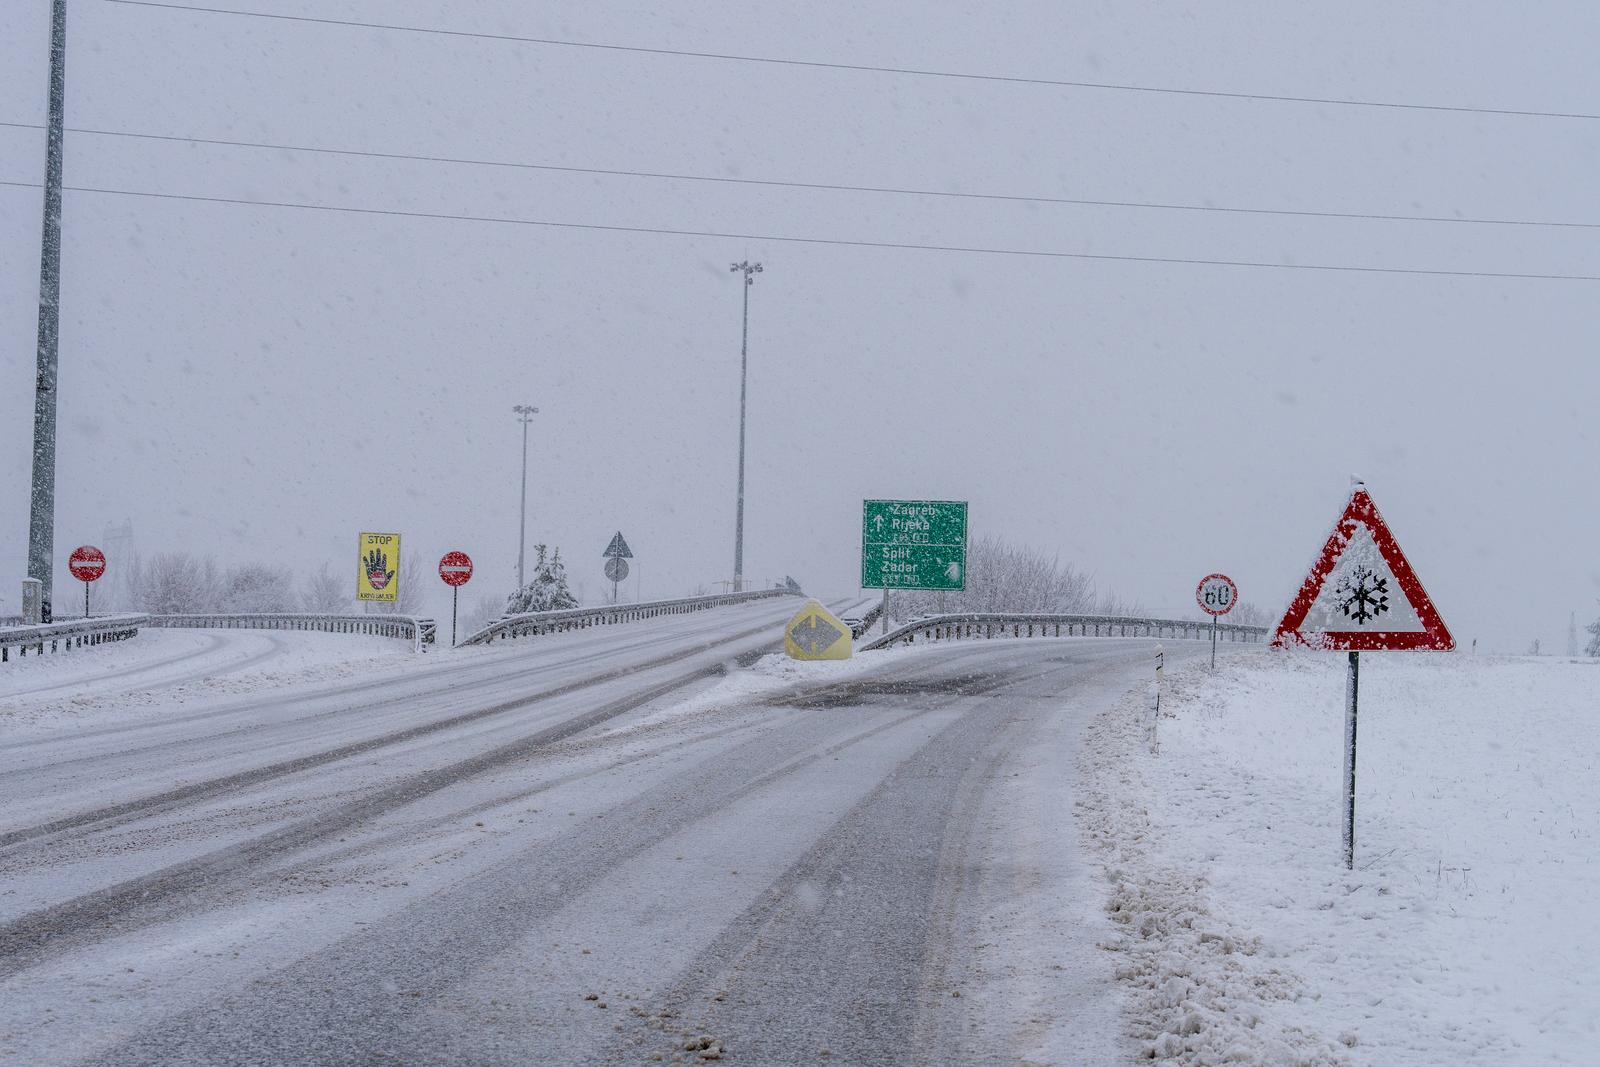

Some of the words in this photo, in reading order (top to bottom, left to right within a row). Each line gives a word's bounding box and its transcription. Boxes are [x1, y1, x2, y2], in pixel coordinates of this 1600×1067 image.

[893, 504, 936, 517] Zagreb
[892, 518, 930, 532] Rijeka
[368, 535, 392, 544] STOP
[882, 547, 910, 561] Split
[881, 560, 918, 573] Zadar
[1205, 585, 1229, 605] 60
